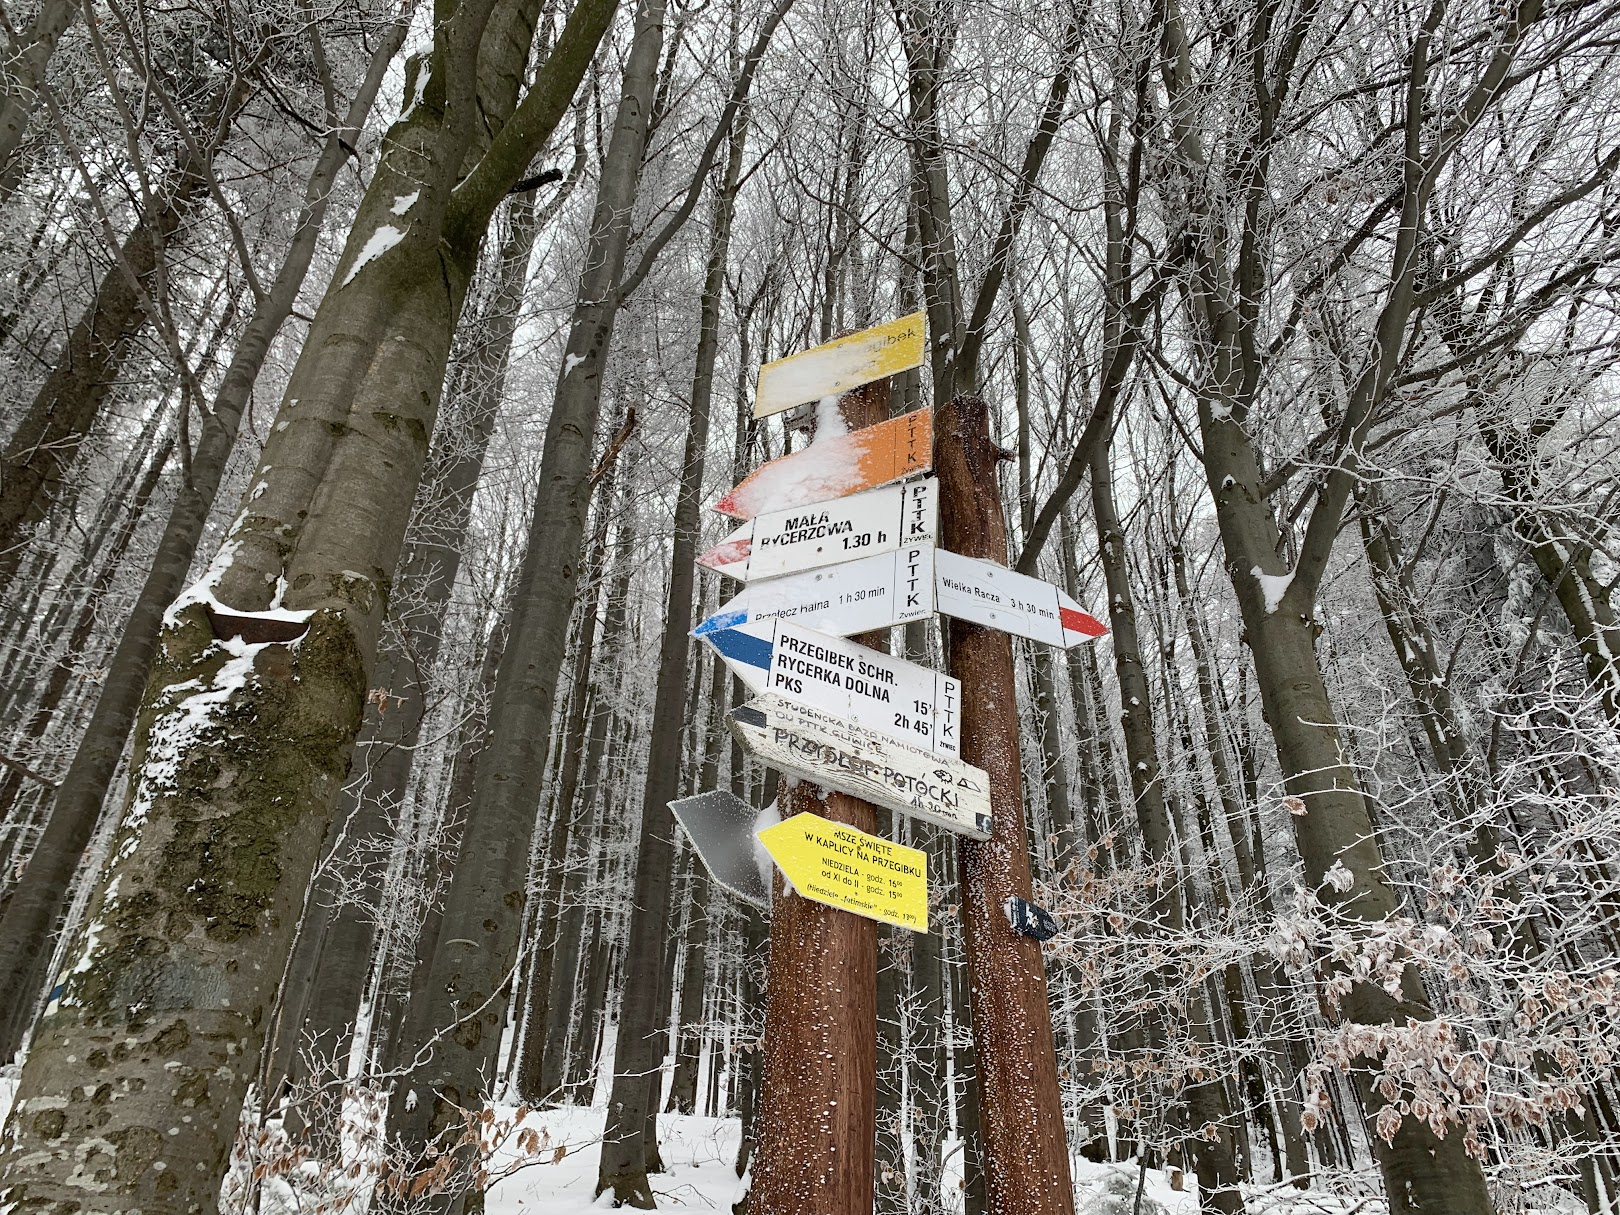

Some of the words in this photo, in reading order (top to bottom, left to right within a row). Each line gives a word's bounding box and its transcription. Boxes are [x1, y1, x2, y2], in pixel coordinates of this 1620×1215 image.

[907, 415, 917, 463] PTTK
[784, 512, 829, 531] MAŁA
[911, 486, 927, 534] PTTK
[843, 533, 871, 550] 1.30
[877, 530, 887, 544] h
[839, 595, 844, 604] 1
[846, 592, 852, 603] h
[854, 589, 866, 602] 30
[868, 586, 885, 599] min
[907, 550, 920, 607] PTTK
[942, 577, 972, 595] Wielka
[974, 587, 1000, 603] Racza
[1010, 599, 1016, 608] 3
[1018, 600, 1024, 610] h
[1026, 602, 1036, 614] 30
[1039, 608, 1055, 620] min
[780, 634, 854, 672] PRZEGIBEK
[858, 661, 898, 686] SCHR.
[775, 673, 803, 694] PKS
[777, 653, 841, 687] RYCERKA
[845, 676, 890, 703] DOLNA
[894, 712, 909, 729] 2h
[944, 681, 955, 739] PTTK
[777, 699, 845, 729] STUDENCKA
[848, 724, 878, 739] BAZA
[881, 736, 950, 768] NAMIOTOWA
[804, 832, 813, 842] W
[816, 836, 854, 857] KAPLICY
[857, 849, 869, 862] NA
[872, 855, 921, 878] PRZEGIBKU
[834, 830, 857, 845] MSZE
[859, 836, 892, 856] ŚWIĘTE
[821, 857, 860, 877] NIEDZIELA
[866, 873, 885, 885] godz.
[821, 870, 831, 879] od
[833, 873, 841, 882] XI
[842, 876, 853, 886] do
[866, 885, 885, 896] godz.
[883, 908, 900, 918] godz.
